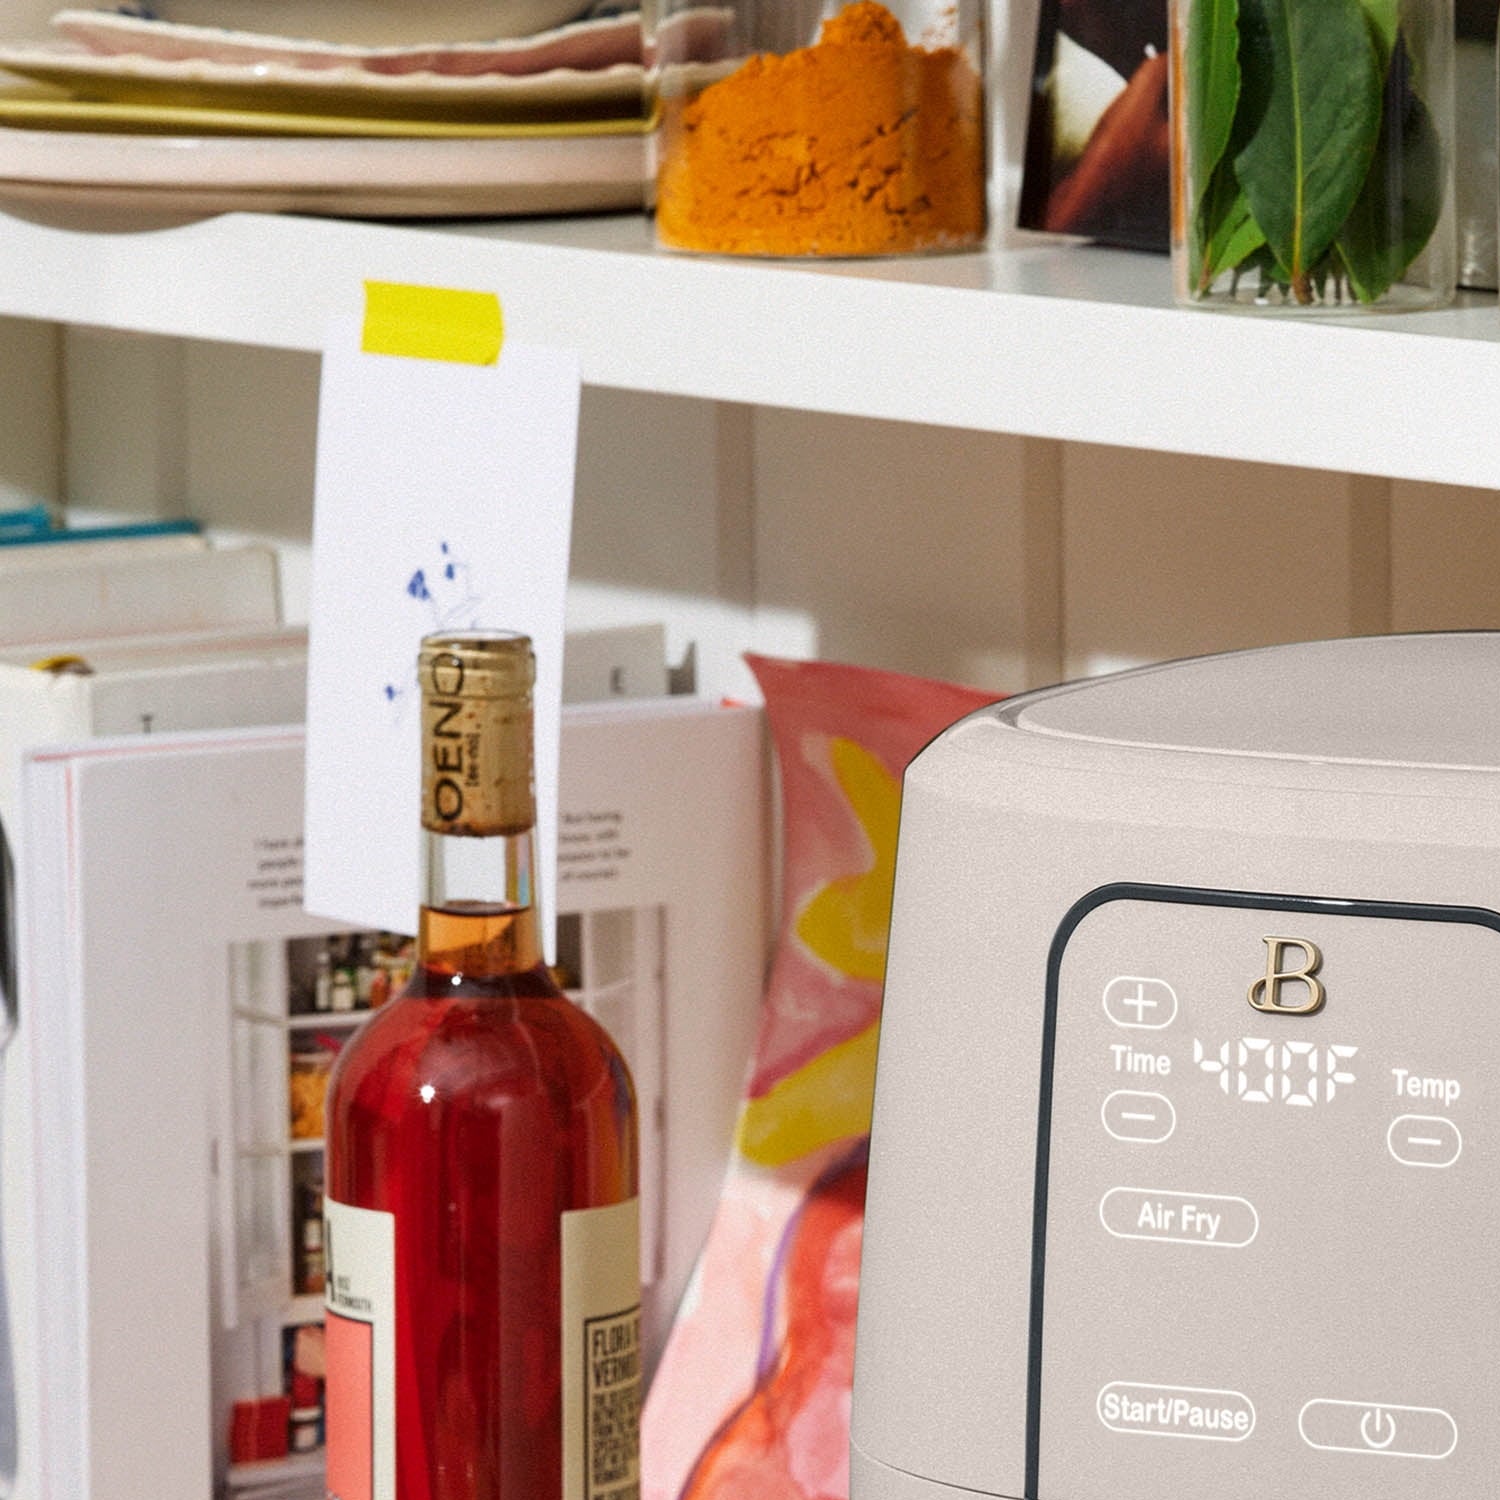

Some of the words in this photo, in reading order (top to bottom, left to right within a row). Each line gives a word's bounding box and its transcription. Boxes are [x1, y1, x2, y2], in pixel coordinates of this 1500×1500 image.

[428, 652, 465, 822] OENO
[1246, 935, 1327, 1015] B
[1109, 1044, 1172, 1076] Time
[1193, 1037, 1359, 1107] 400F
[1391, 1068, 1461, 1106] Temp
[1137, 1201, 1175, 1230] Air
[1180, 1204, 1221, 1241] Fry
[1103, 1392, 1250, 1431] Start/Pause
